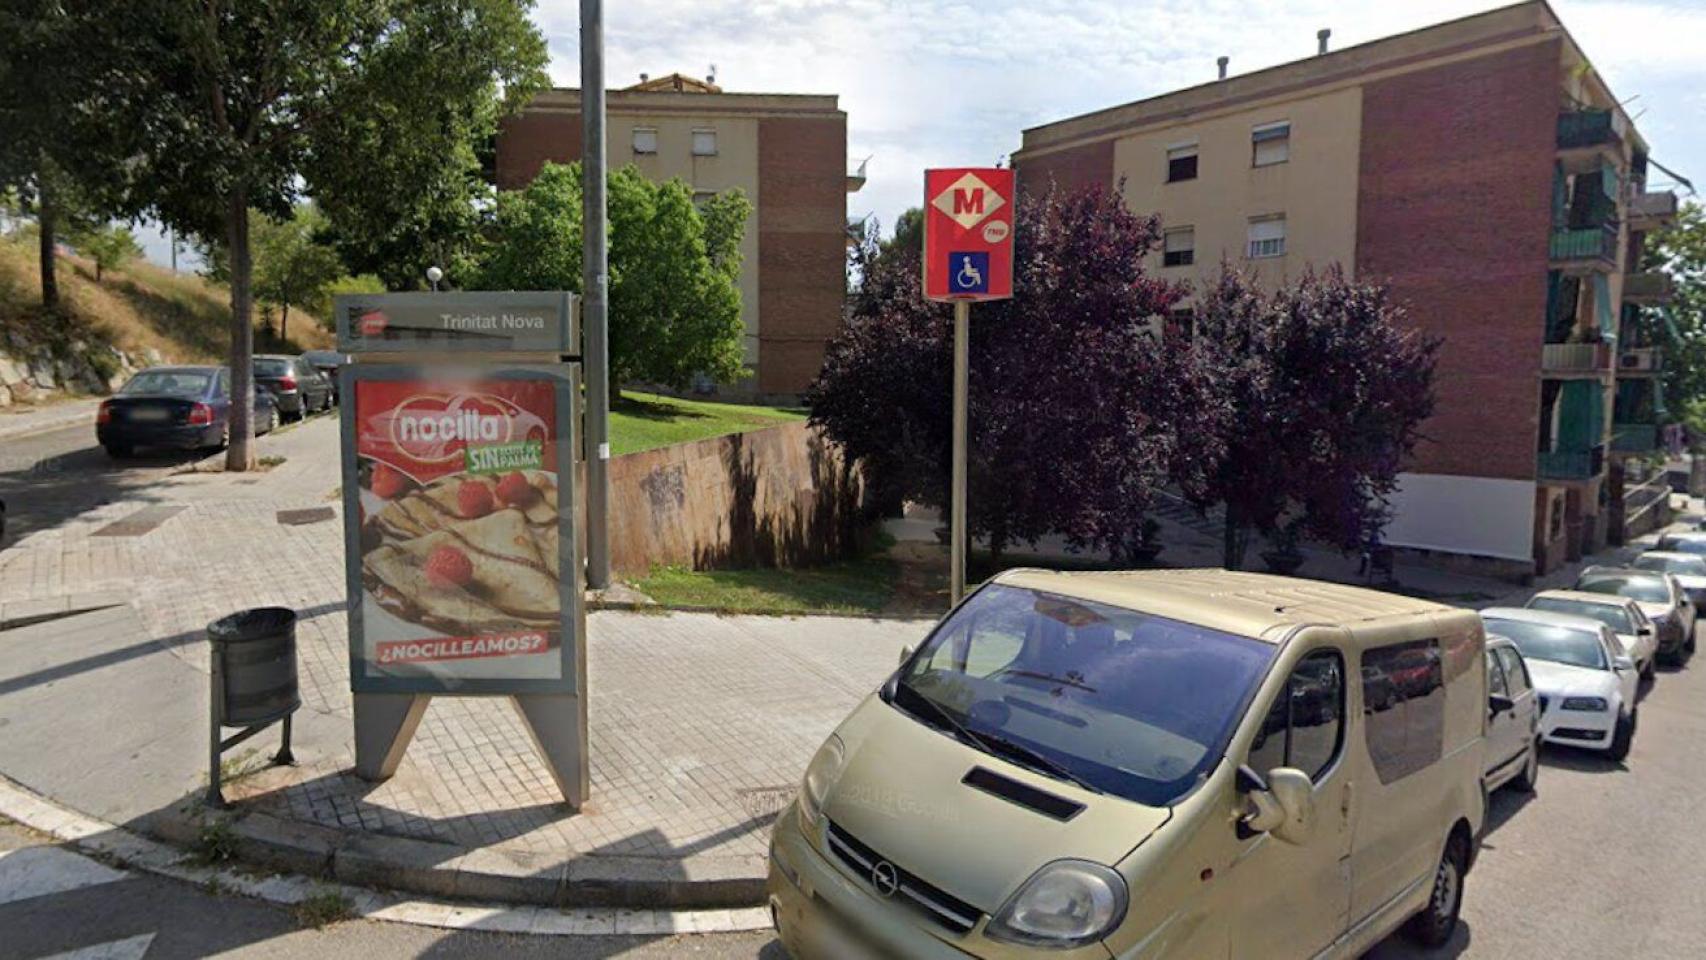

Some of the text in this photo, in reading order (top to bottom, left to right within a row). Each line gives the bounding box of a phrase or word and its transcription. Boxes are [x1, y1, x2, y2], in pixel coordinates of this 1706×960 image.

[954, 188, 984, 214] M
[441, 314, 545, 329] Trinitat Nova
[400, 409, 499, 441] nocilla
[470, 447, 498, 472] SIN
[381, 635, 541, 662] ¿NOCILLEAMOS?
